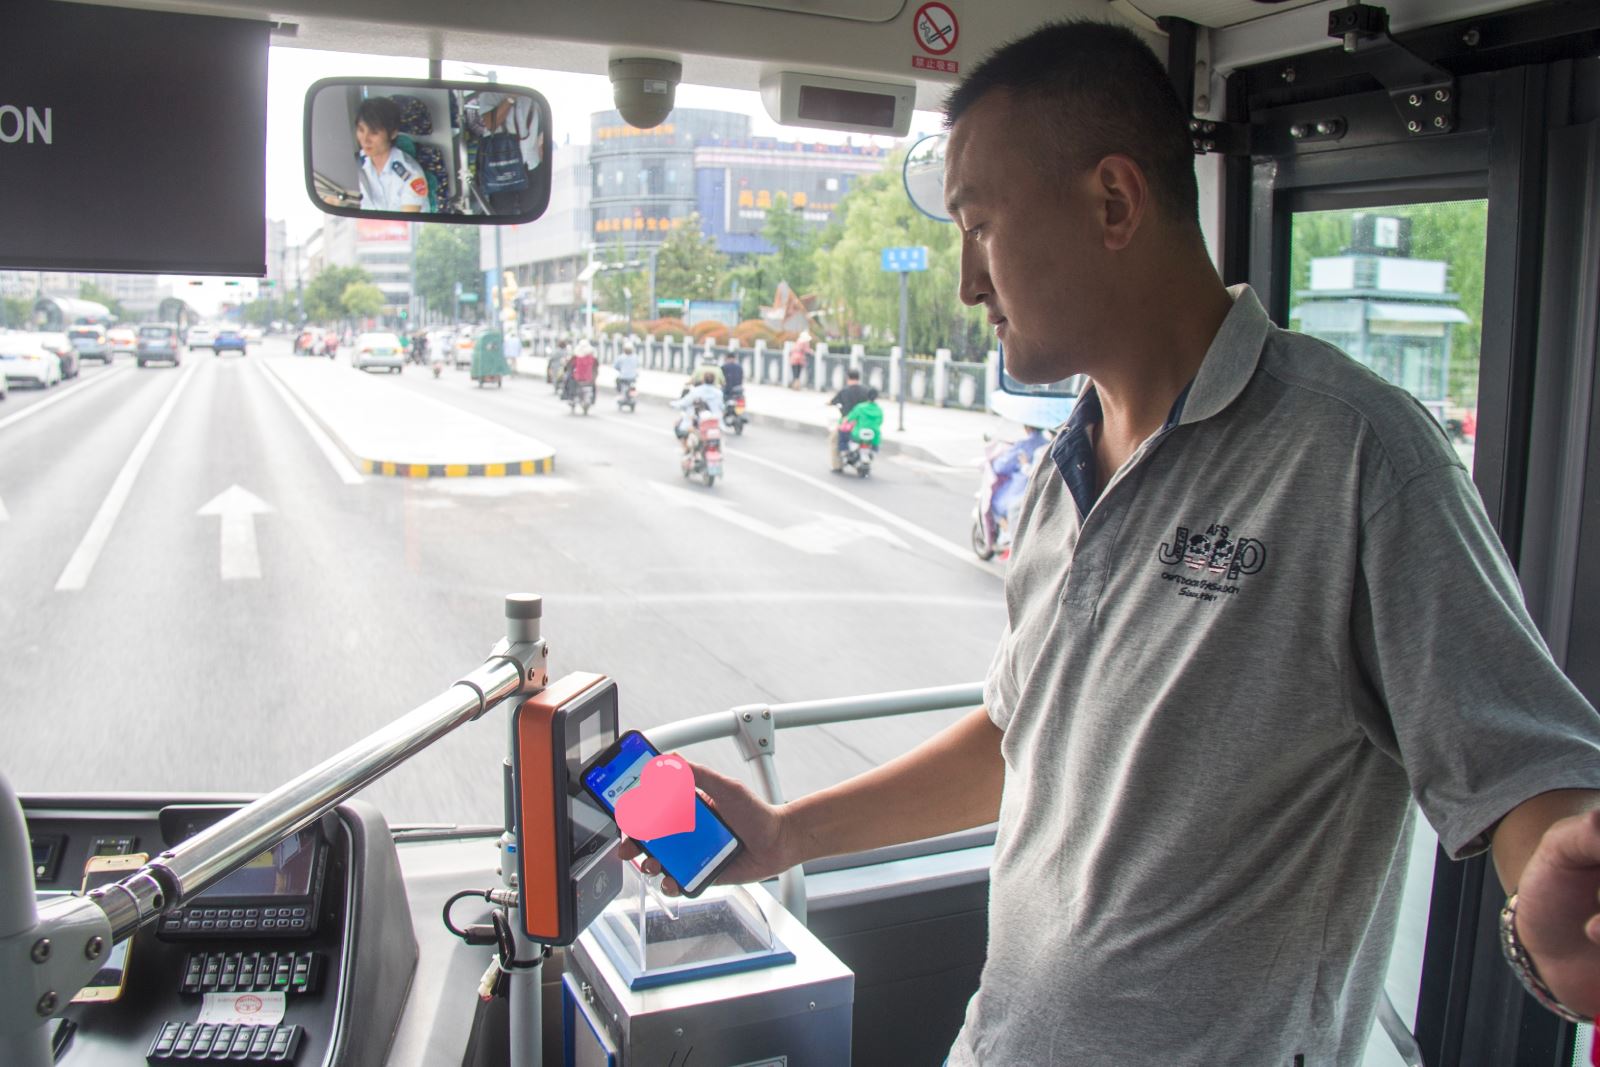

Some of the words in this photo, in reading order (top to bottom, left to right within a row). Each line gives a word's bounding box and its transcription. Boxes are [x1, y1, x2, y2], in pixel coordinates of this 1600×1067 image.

[915, 57, 956, 72] 禁止吸烟
[0, 104, 52, 144] ON
